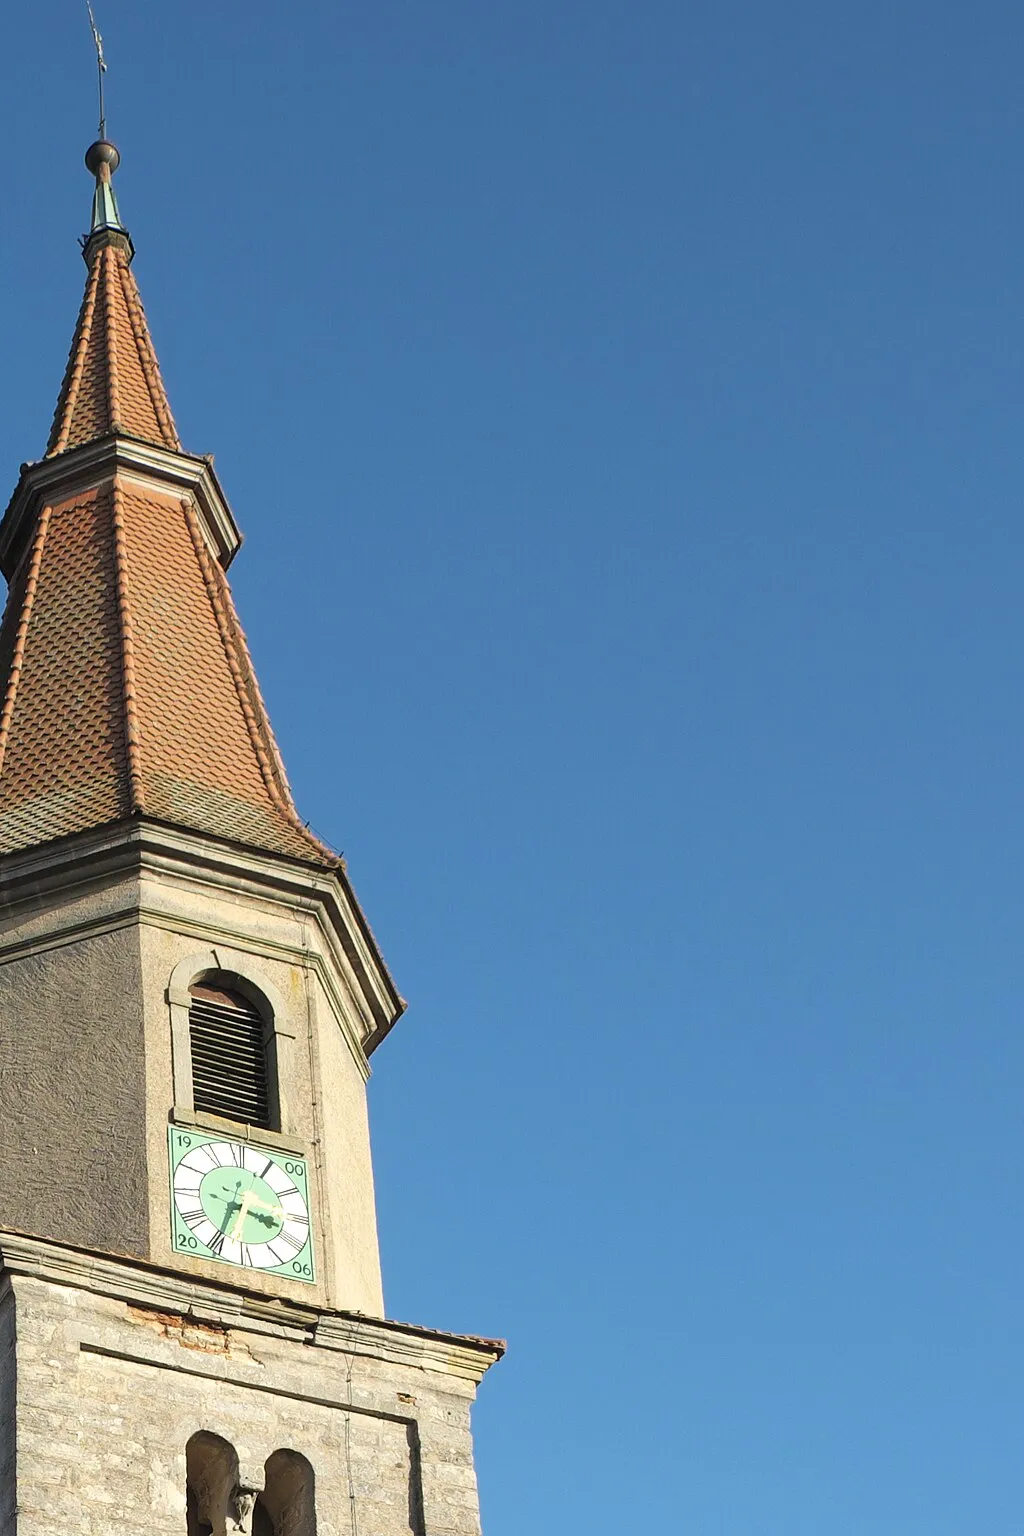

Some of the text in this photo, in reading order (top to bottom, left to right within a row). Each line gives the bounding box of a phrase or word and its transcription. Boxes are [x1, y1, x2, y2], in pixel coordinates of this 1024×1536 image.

[176, 1135, 192, 1148] 19
[285, 1162, 304, 1176] 00
[178, 1234, 198, 1249] 20
[292, 1261, 311, 1276] 06
